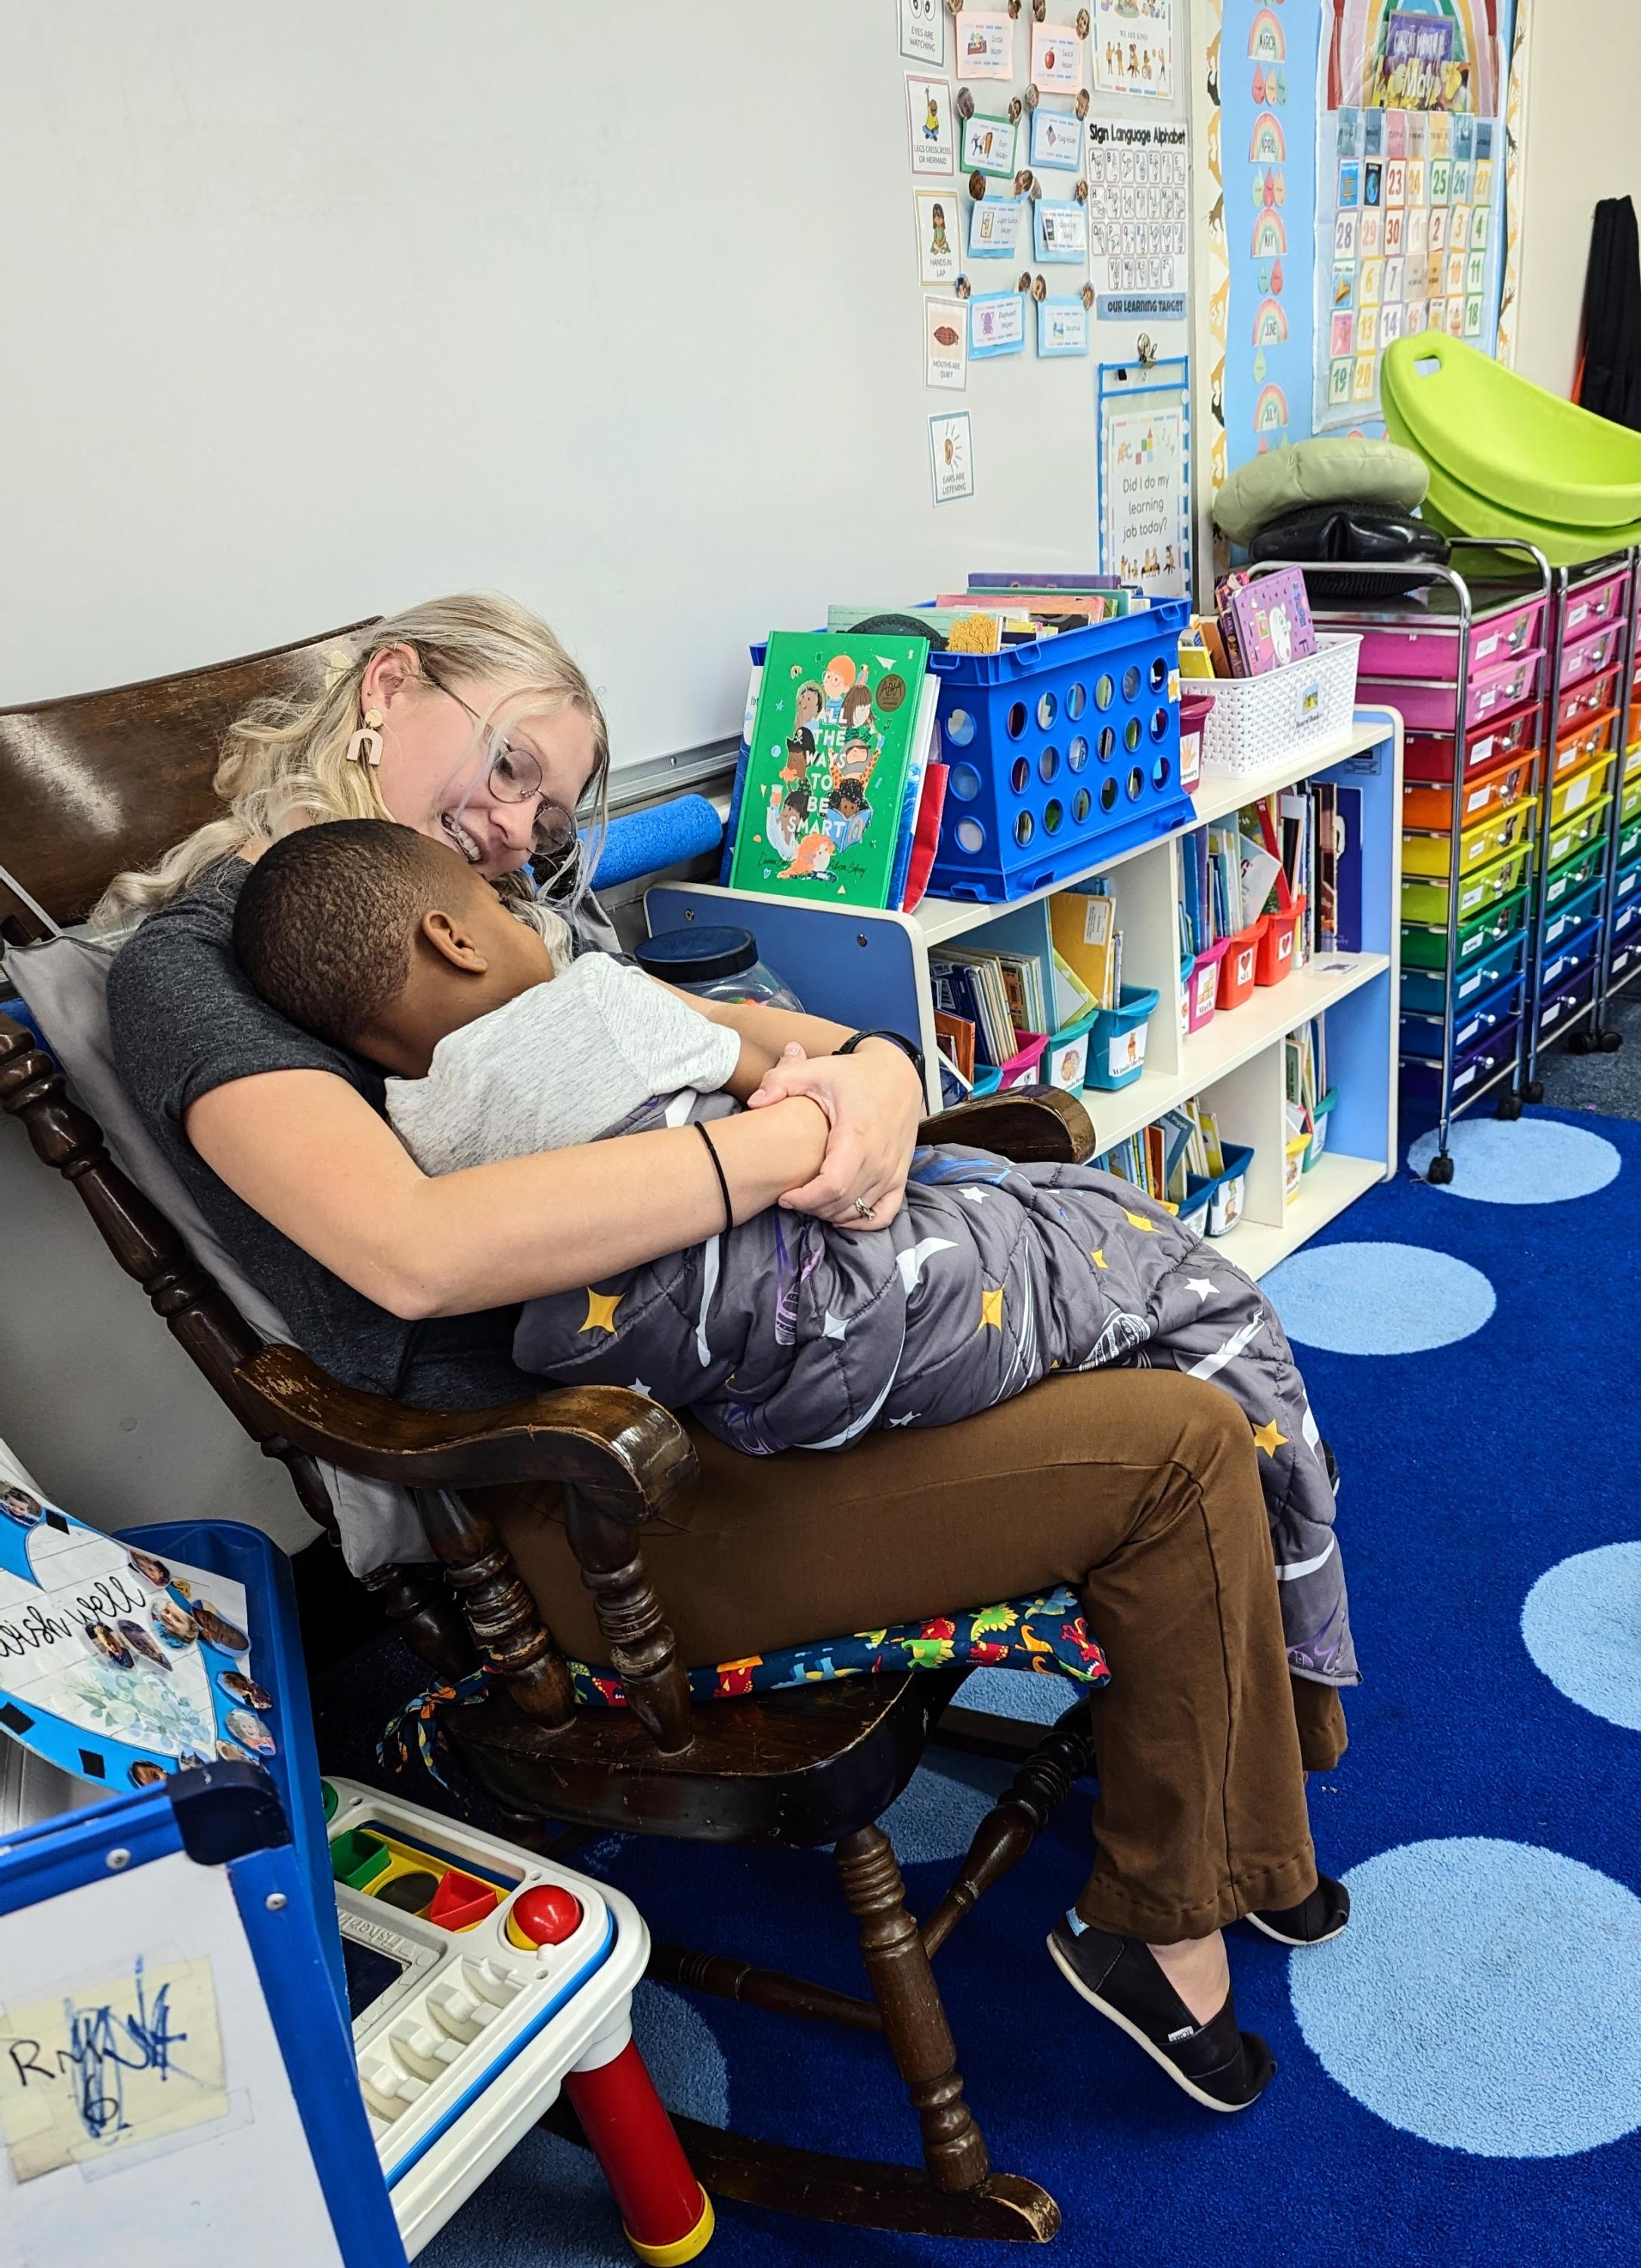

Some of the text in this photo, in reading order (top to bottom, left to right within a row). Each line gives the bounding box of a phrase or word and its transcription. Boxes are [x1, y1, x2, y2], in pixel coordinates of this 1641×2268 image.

[912, 26, 934, 39] EYES ARE
[910, 37, 935, 51] WATCHING
[1260, 35, 1275, 50] MARCH
[1089, 123, 1186, 147] Sign Language Alphabet
[915, 144, 951, 156] LEGS CRISSCROSS
[1262, 139, 1274, 153] APRIL
[925, 156, 946, 165] MERMAID
[1091, 153, 1095, 162] A
[1107, 153, 1110, 163] B
[1122, 153, 1126, 163] C
[1136, 154, 1139, 163] D
[1150, 154, 1153, 164] E
[1389, 169, 1489, 195] 23 24 25 26 27
[1093, 189, 1096, 198] H
[1108, 189, 1111, 198] I
[1123, 191, 1126, 199] J
[1137, 191, 1140, 199] K
[1150, 191, 1152, 200] L
[1094, 226, 1098, 236] O
[1110, 227, 1112, 235] P
[1124, 227, 1127, 236] Q
[1137, 228, 1141, 236] R
[1163, 227, 1165, 235] T
[1175, 227, 1178, 235] U
[1336, 214, 1482, 249] 28 29 30 1 2 3 4
[1110, 262, 1114, 271] V
[1125, 262, 1129, 271] W
[1138, 262, 1141, 270] X
[1150, 262, 1153, 270] Y
[1366, 267, 1374, 293] 6
[1390, 266, 1397, 292] 7
[1451, 260, 1461, 290] 10
[1470, 259, 1481, 284] 11
[1107, 300, 1122, 312] OUR
[1158, 300, 1184, 311] TARGET
[1265, 321, 1277, 336] JUNE
[1361, 315, 1373, 341] 13
[1383, 311, 1398, 337] 14
[1468, 302, 1478, 331] 18
[934, 361, 952, 370] MOUTHS
[940, 370, 953, 379] QUIET
[1333, 366, 1370, 393] 19 20
[1161, 427, 1166, 441] 2
[1117, 442, 1133, 465] ABC
[943, 475, 954, 484] EARS
[1123, 474, 1169, 493] Did I do my
[943, 483, 966, 495] LISTENING
[1129, 497, 1165, 516] learning
[1122, 517, 1168, 544] job today?
[818, 708, 847, 723] ALL
[815, 730, 847, 747] THE
[806, 750, 846, 770] WAYS
[811, 773, 832, 792] TO
[807, 795, 829, 813] BE
[787, 817, 846, 837] SMART
[63, 1576, 145, 1625] well
